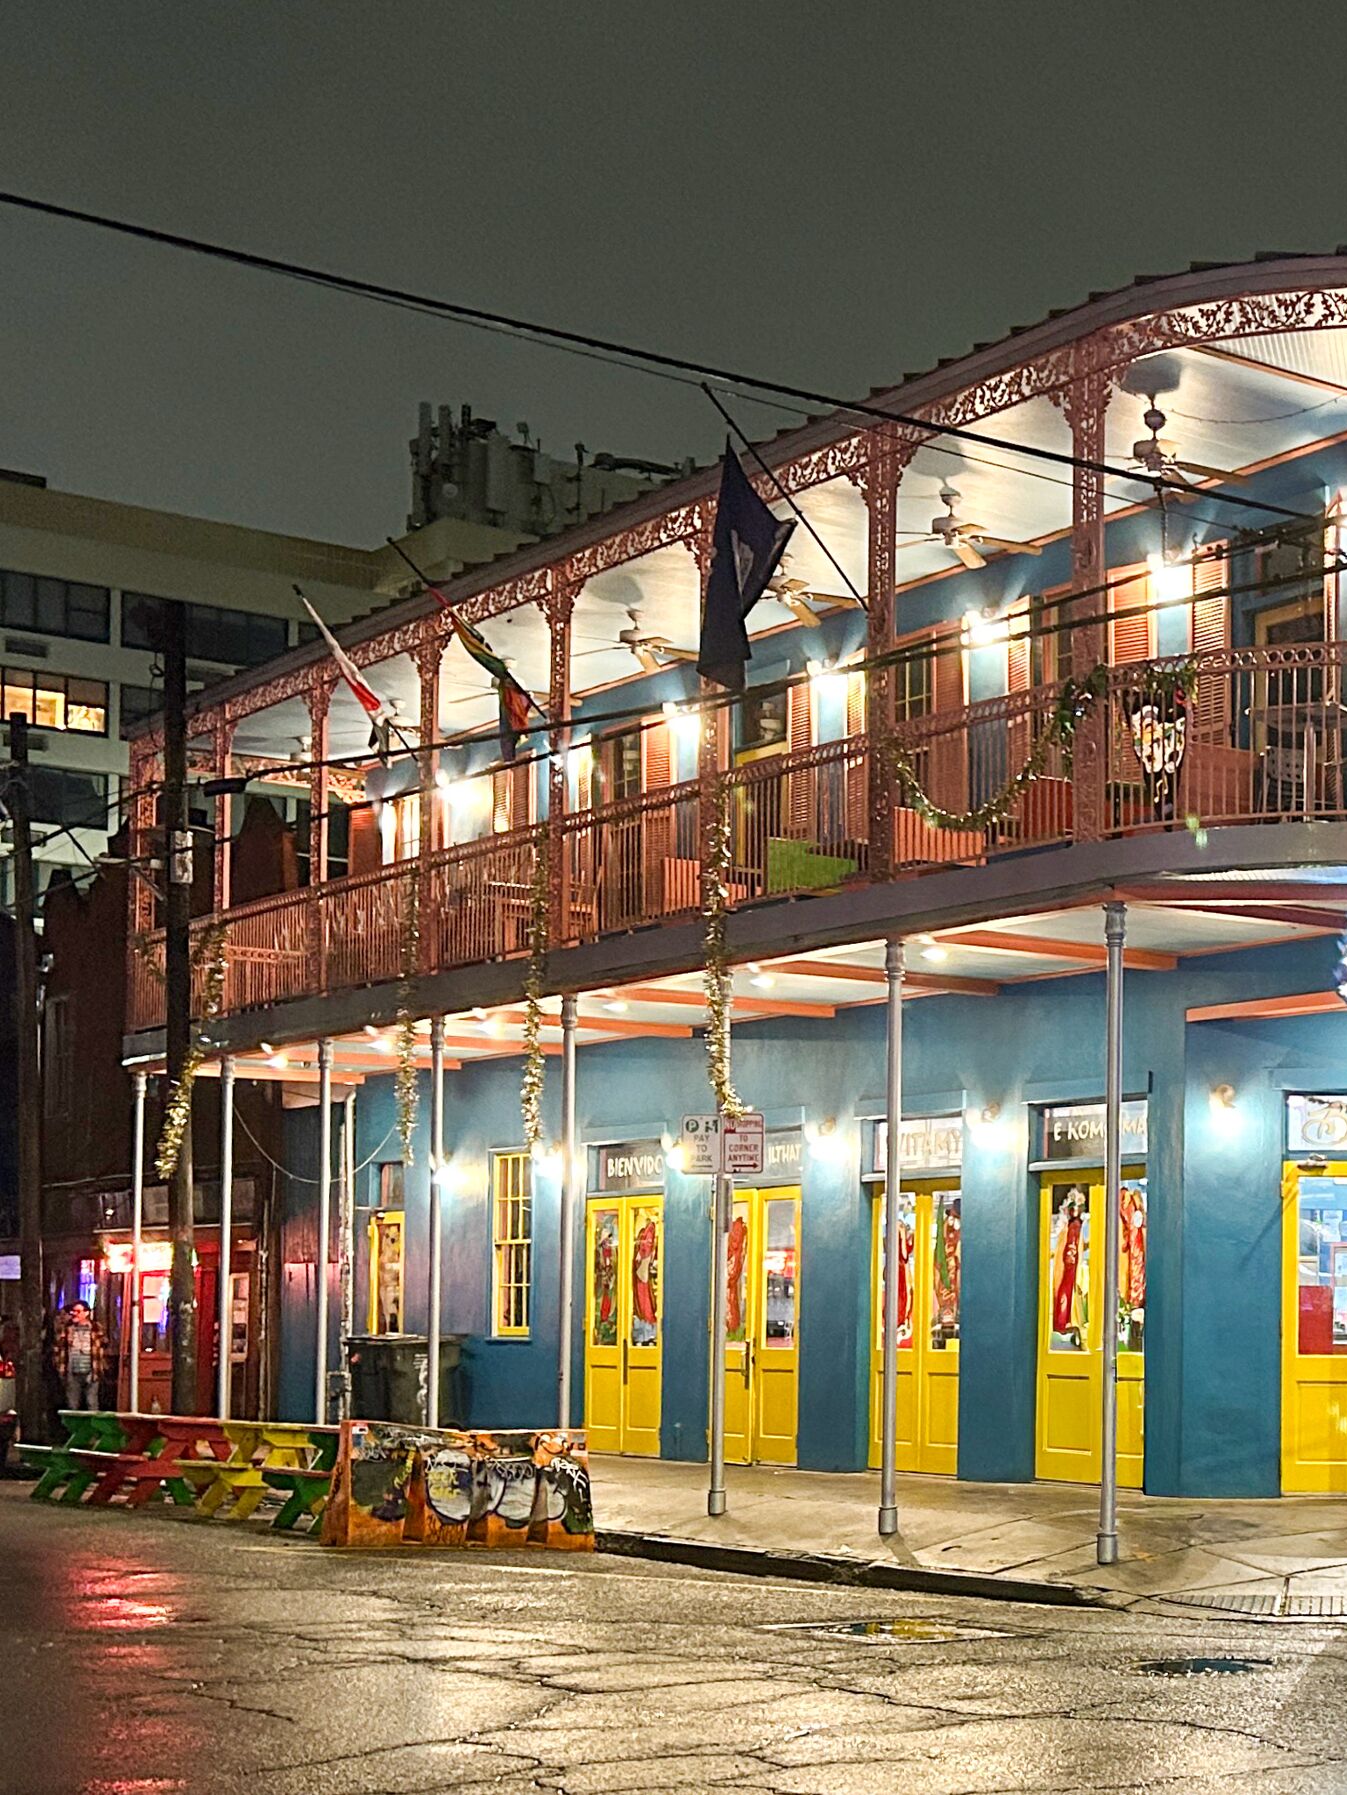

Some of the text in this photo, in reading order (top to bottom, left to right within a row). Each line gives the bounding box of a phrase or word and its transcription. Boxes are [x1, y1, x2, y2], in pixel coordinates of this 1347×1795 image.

[1054, 1122, 1062, 1141] E
[1067, 1117, 1106, 1141] KOM
[739, 1135, 748, 1143] TO
[696, 1144, 708, 1153] TO
[728, 1144, 759, 1152] CORNER
[727, 1154, 759, 1162] ANYTIME
